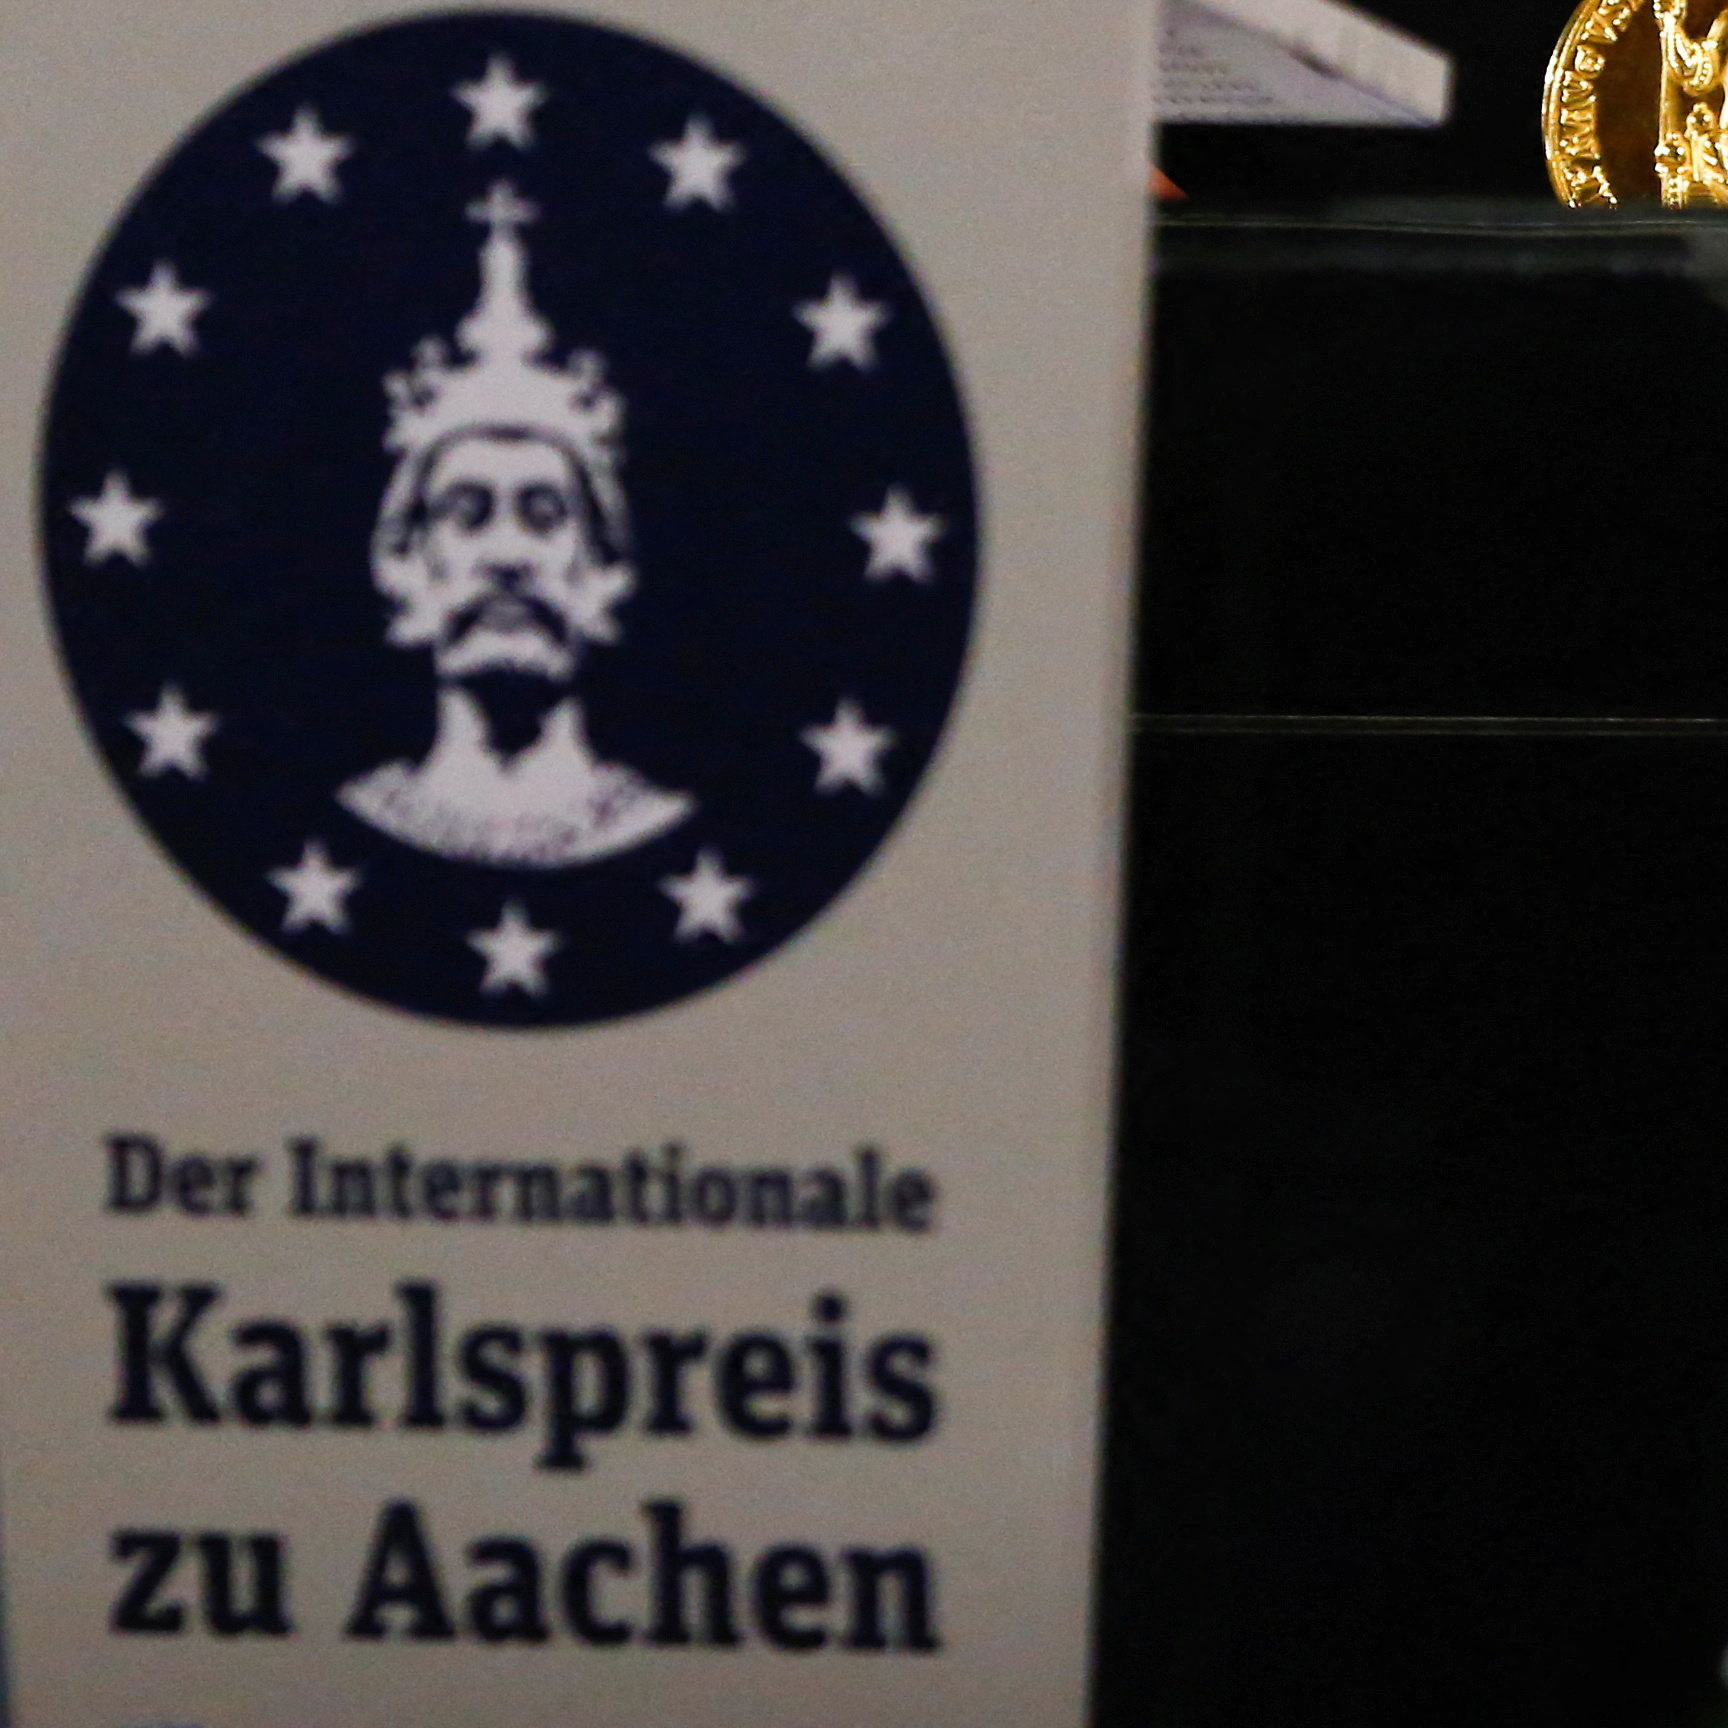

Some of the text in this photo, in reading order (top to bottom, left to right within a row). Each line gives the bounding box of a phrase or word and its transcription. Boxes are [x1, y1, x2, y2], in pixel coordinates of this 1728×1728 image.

[103, 1132, 939, 1235] Der Internationale
[104, 1278, 942, 1477] Karlspreis
[106, 1495, 946, 1657] zu Aachen
